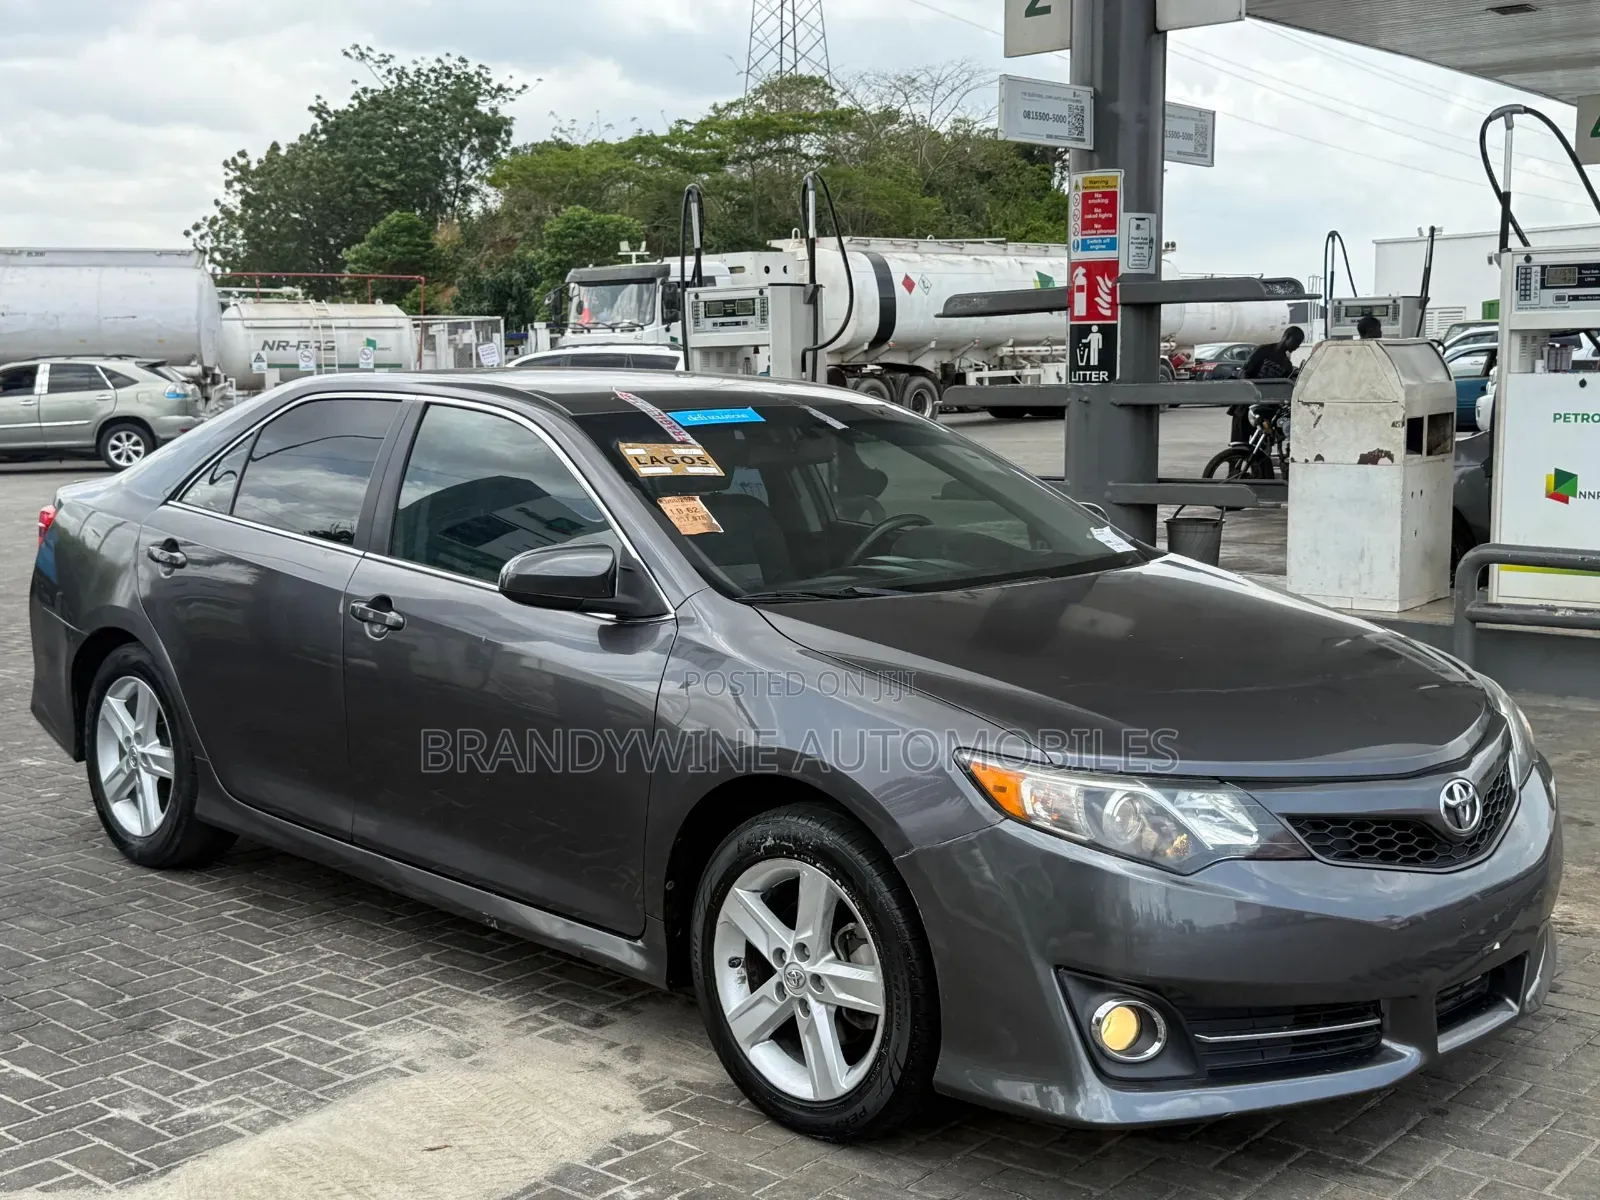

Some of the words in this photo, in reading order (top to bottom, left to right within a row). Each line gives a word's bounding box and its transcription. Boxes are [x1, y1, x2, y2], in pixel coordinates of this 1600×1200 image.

[1022, 109, 1067, 124] 0815500-5000
[1071, 370, 1109, 382] LITTER
[1552, 412, 1600, 424] PETRO
[633, 455, 711, 466] LAGOS
